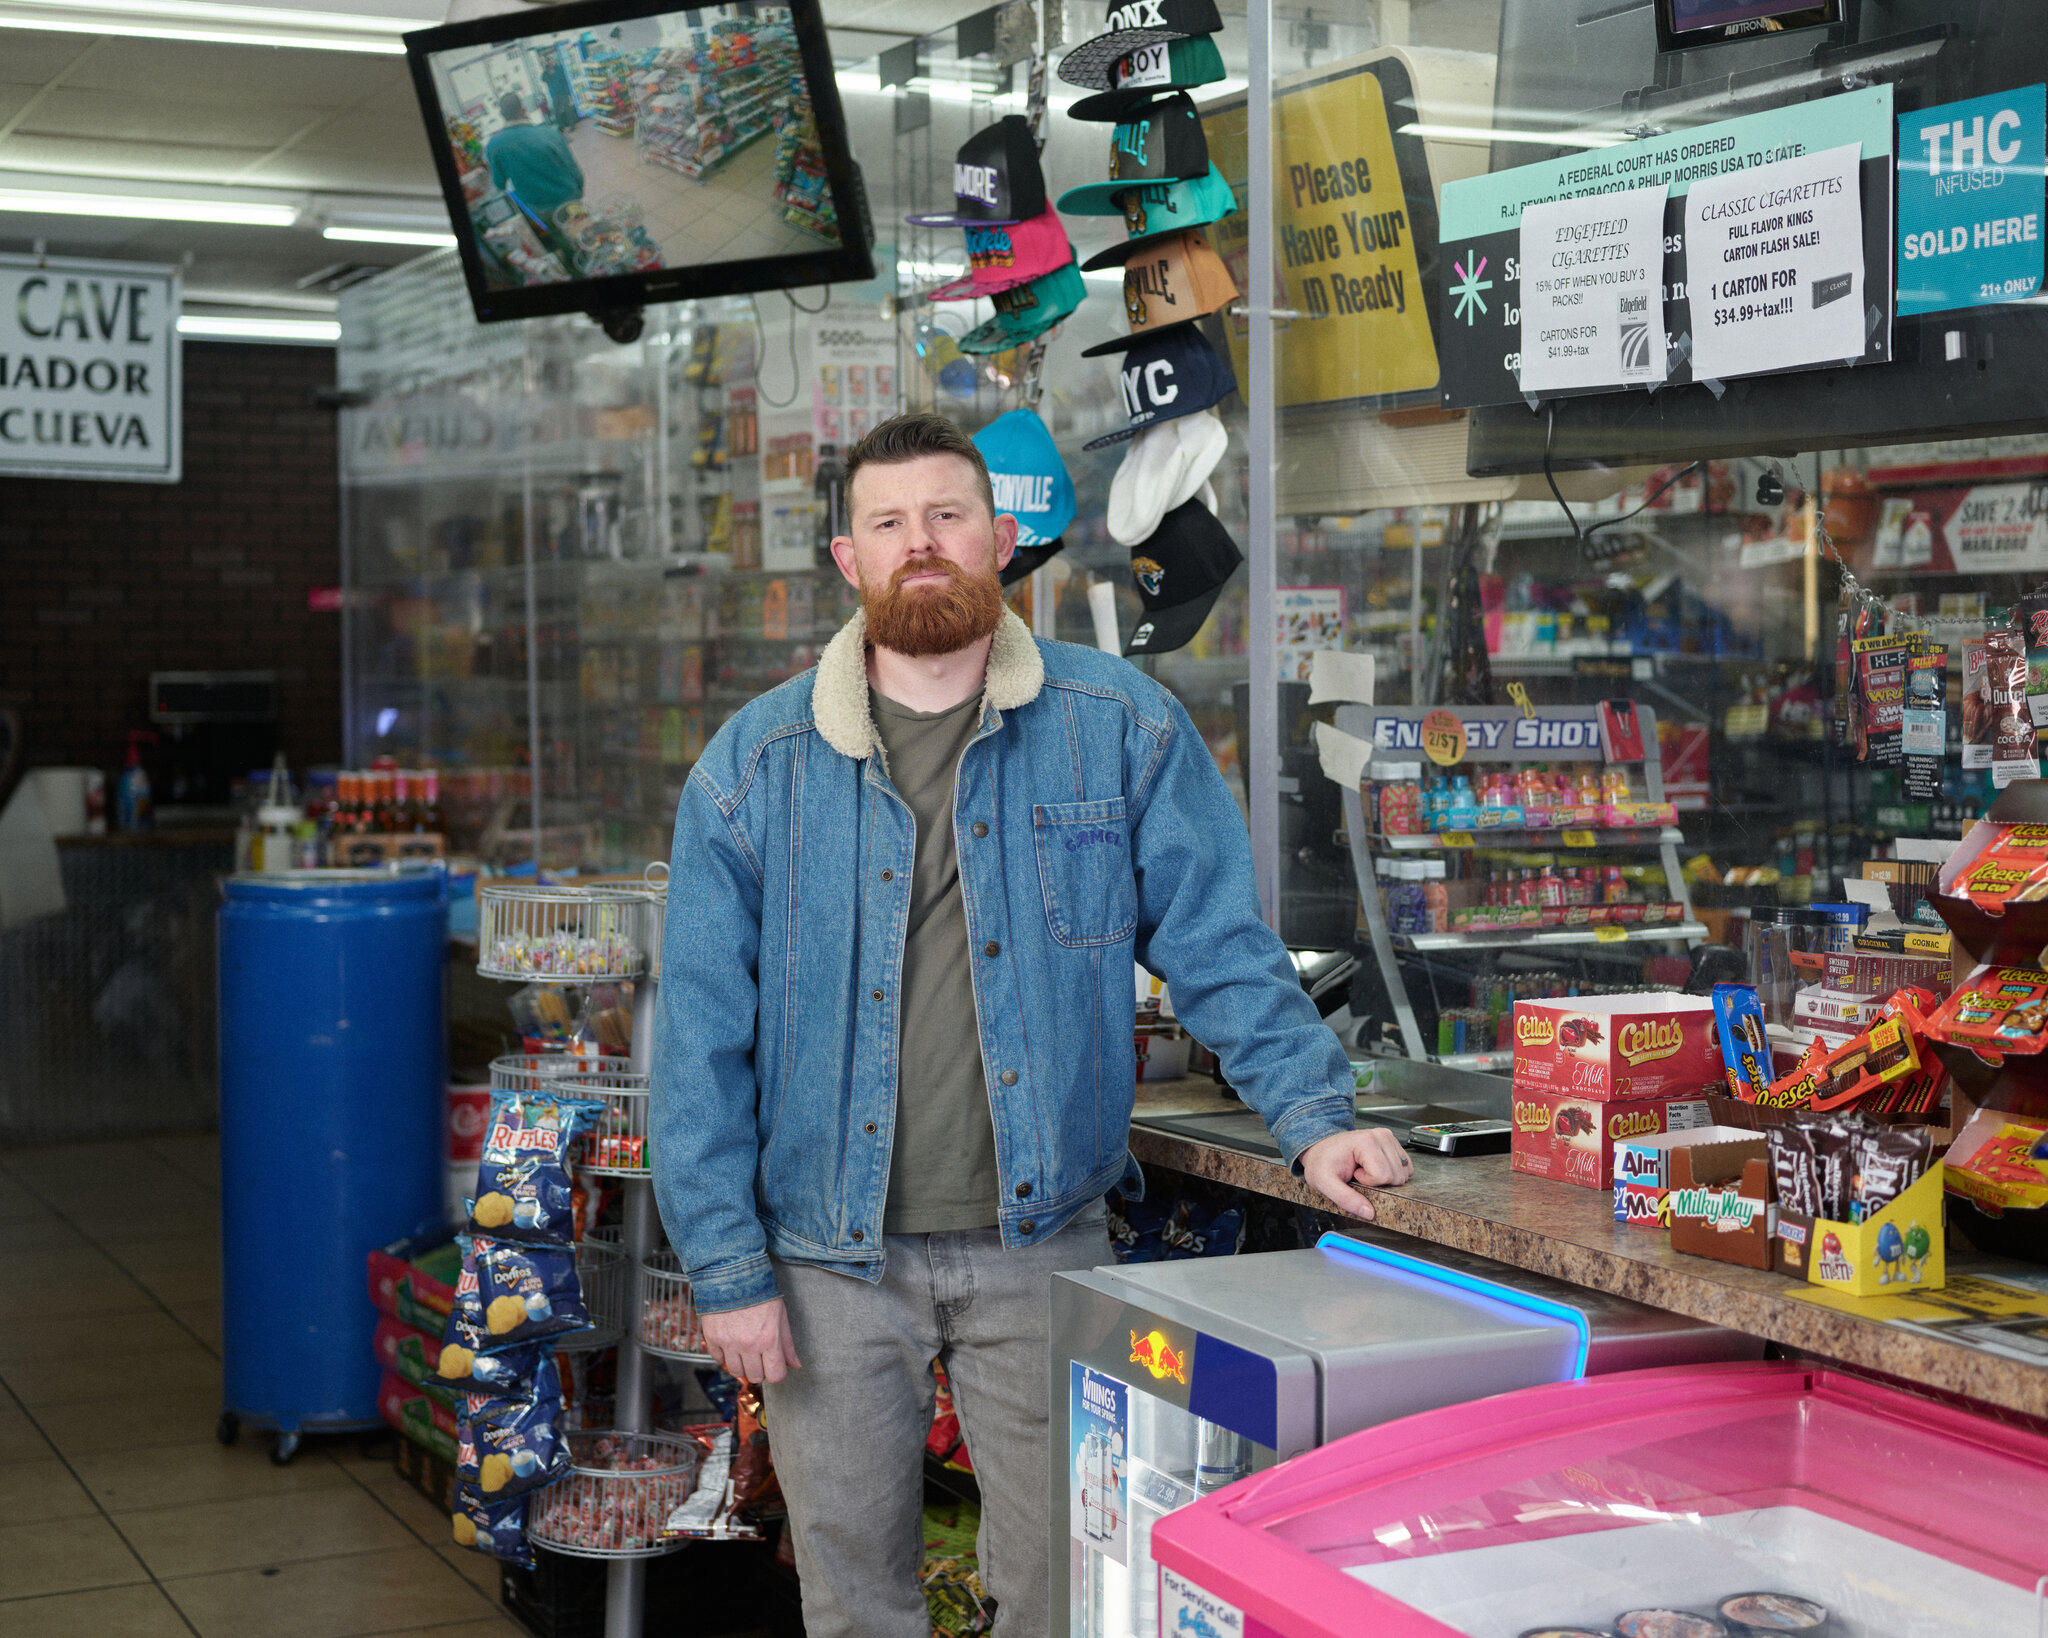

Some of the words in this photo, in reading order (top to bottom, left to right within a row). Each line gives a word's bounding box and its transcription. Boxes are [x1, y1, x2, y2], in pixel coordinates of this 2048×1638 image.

[1104, 0, 1167, 33] ONX
[1920, 108, 2021, 176] THC
[1558, 173, 1565, 187] A
[1568, 163, 1613, 184] FEDERAL
[1616, 154, 1653, 174] COURT
[1656, 147, 1678, 166] HAS
[1681, 136, 1736, 160] ORDERED
[1290, 157, 1372, 209] Please
[1501, 205, 1518, 219] R.J.
[1638, 171, 1672, 189] PHILIP
[1674, 161, 1718, 184] MORRIS
[1721, 155, 1744, 174] USA
[1747, 153, 1763, 168] TO
[1765, 143, 1806, 165] STATE:
[1935, 167, 2005, 197] INFUSED
[1701, 196, 1756, 222] CLASSIC
[1759, 176, 1843, 210] CIGARETTES
[1555, 218, 1628, 244] EDGEFIELD
[1728, 223, 1749, 240] FULL
[1751, 216, 1784, 236] FLAVOR
[1786, 210, 1814, 228] KINGS
[1904, 226, 1968, 260] SOLD
[1973, 213, 2038, 249] HERE
[1280, 223, 1341, 268] Have
[1342, 209, 1406, 255] Your
[1723, 245, 1758, 263] CARTON
[1760, 237, 1790, 256] FLASH
[1792, 230, 1821, 249] SALE!
[1551, 243, 1630, 270] CIGARETTES
[1302, 277, 1329, 321] ID
[1330, 265, 1406, 316] Ready
[1535, 280, 1553, 293] 15%
[1554, 277, 1571, 291] OFF
[1572, 274, 1598, 288] WHEN
[1599, 272, 1618, 286] YOU
[1619, 269, 1637, 284] BUY
[1639, 268, 1645, 281] 3
[1711, 284, 1717, 300] 1
[1722, 272, 1768, 298] CARTON
[1771, 268, 1797, 290] FOR
[1980, 282, 2002, 297] 21+
[2003, 276, 2037, 294] ONLY
[17, 275, 152, 344] CAVE
[1620, 295, 1647, 315] Edgefield
[1713, 296, 1794, 327] $34.99+tax!!!
[1540, 327, 1579, 342] CARTONS
[1580, 326, 1598, 338] FOR
[1548, 344, 1590, 359] $41.99+tax
[0, 407, 150, 451] CUEVA
[1858, 641, 1866, 651] 4
[1867, 637, 1897, 649] WRAPS
[1373, 717, 1508, 750] ENGY
[1997, 735, 2032, 745] COCOA
[1065, 828, 1124, 853] CAMEL
[1911, 938, 1940, 949] COGNAC
[1828, 957, 1850, 967] SWISHER
[1828, 966, 1848, 975] SWEETS
[1820, 1002, 1839, 1018] MINI
[1841, 1005, 1858, 1015] TWIN
[1517, 1015, 1554, 1040] Cella's
[1618, 1018, 1684, 1057] Cella's
[1873, 1025, 1894, 1041] KING
[1876, 1033, 1897, 1049] SIZE
[1515, 1056, 1528, 1075] 72
[1572, 1061, 1605, 1088] Milk
[1572, 1085, 1605, 1095] CHOCOLATE
[1615, 1077, 1632, 1096] 72
[1515, 1101, 1551, 1125] Cella's
[1608, 1108, 1661, 1140] Cella's
[489, 1125, 557, 1150] RUFFLES
[1514, 1150, 1527, 1169] 72
[1565, 1149, 1596, 1176] Milk
[1676, 1188, 1719, 1223] Milky
[1721, 1190, 1754, 1227] Way
[1779, 1221, 1806, 1243] SNICKERS
[494, 1266, 532, 1284] Doritos
[1082, 1398, 1091, 1411] FOR
[1090, 1403, 1102, 1417] YOUR
[1101, 1408, 1117, 1425] SPRING.
[1165, 1572, 1179, 1593] For
[1181, 1583, 1215, 1616] Service
[1217, 1606, 1240, 1631] Call:
